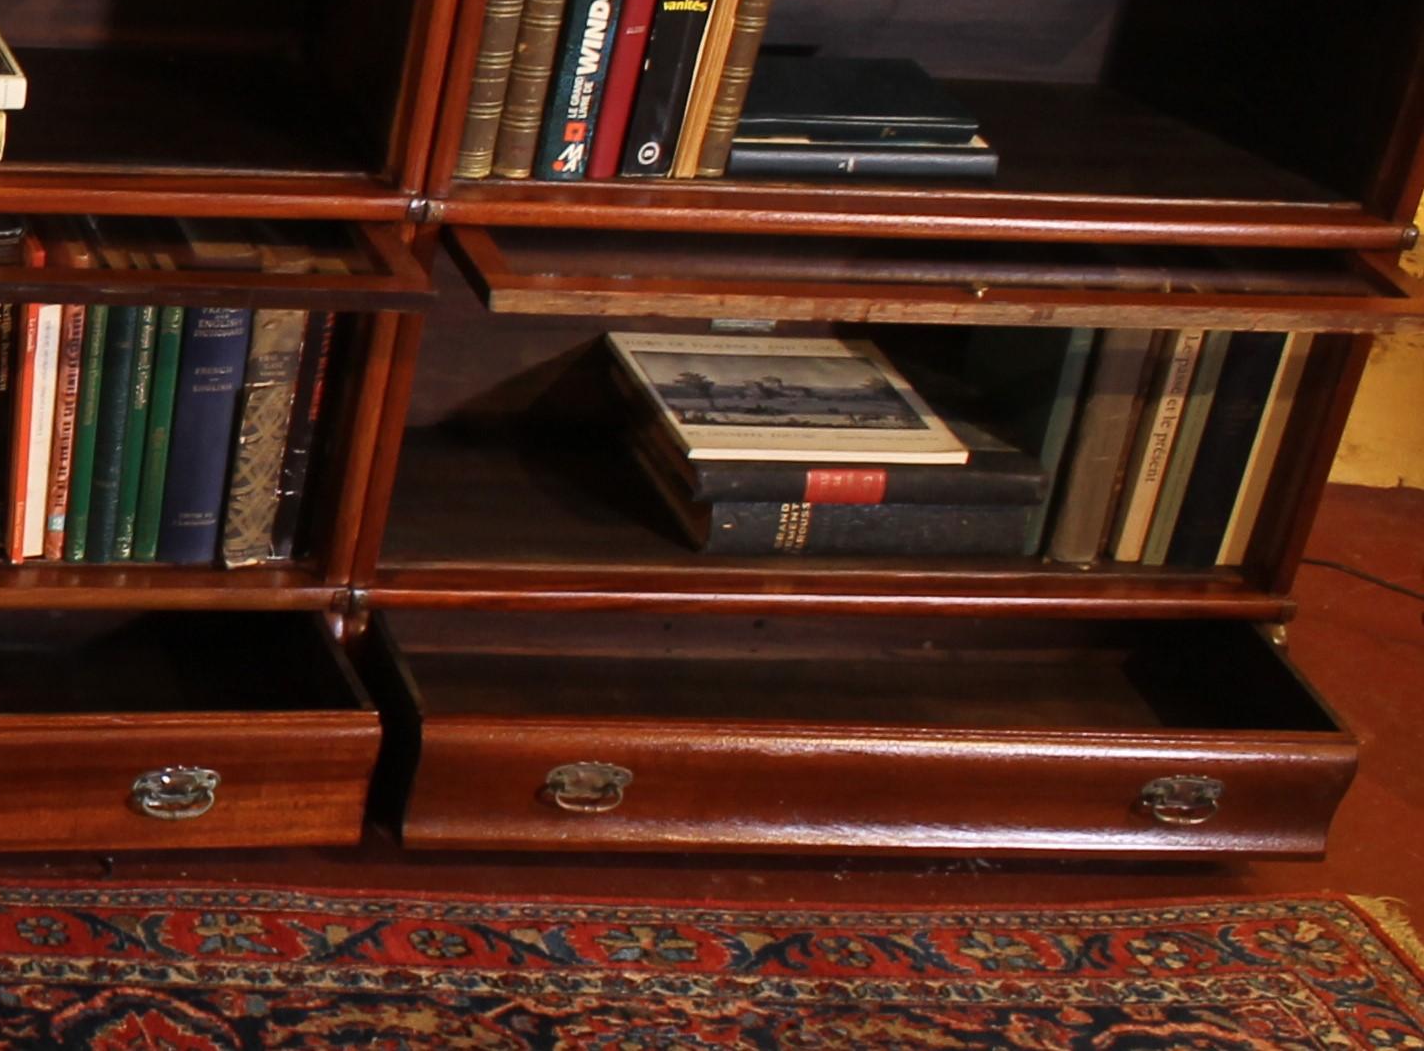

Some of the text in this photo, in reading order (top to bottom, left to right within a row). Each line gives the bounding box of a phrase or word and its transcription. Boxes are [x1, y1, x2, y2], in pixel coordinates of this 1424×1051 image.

[1183, 335, 1200, 354] Le
[1165, 398, 1178, 412] et
[1160, 415, 1177, 429] le
[1145, 431, 1168, 483] présent
